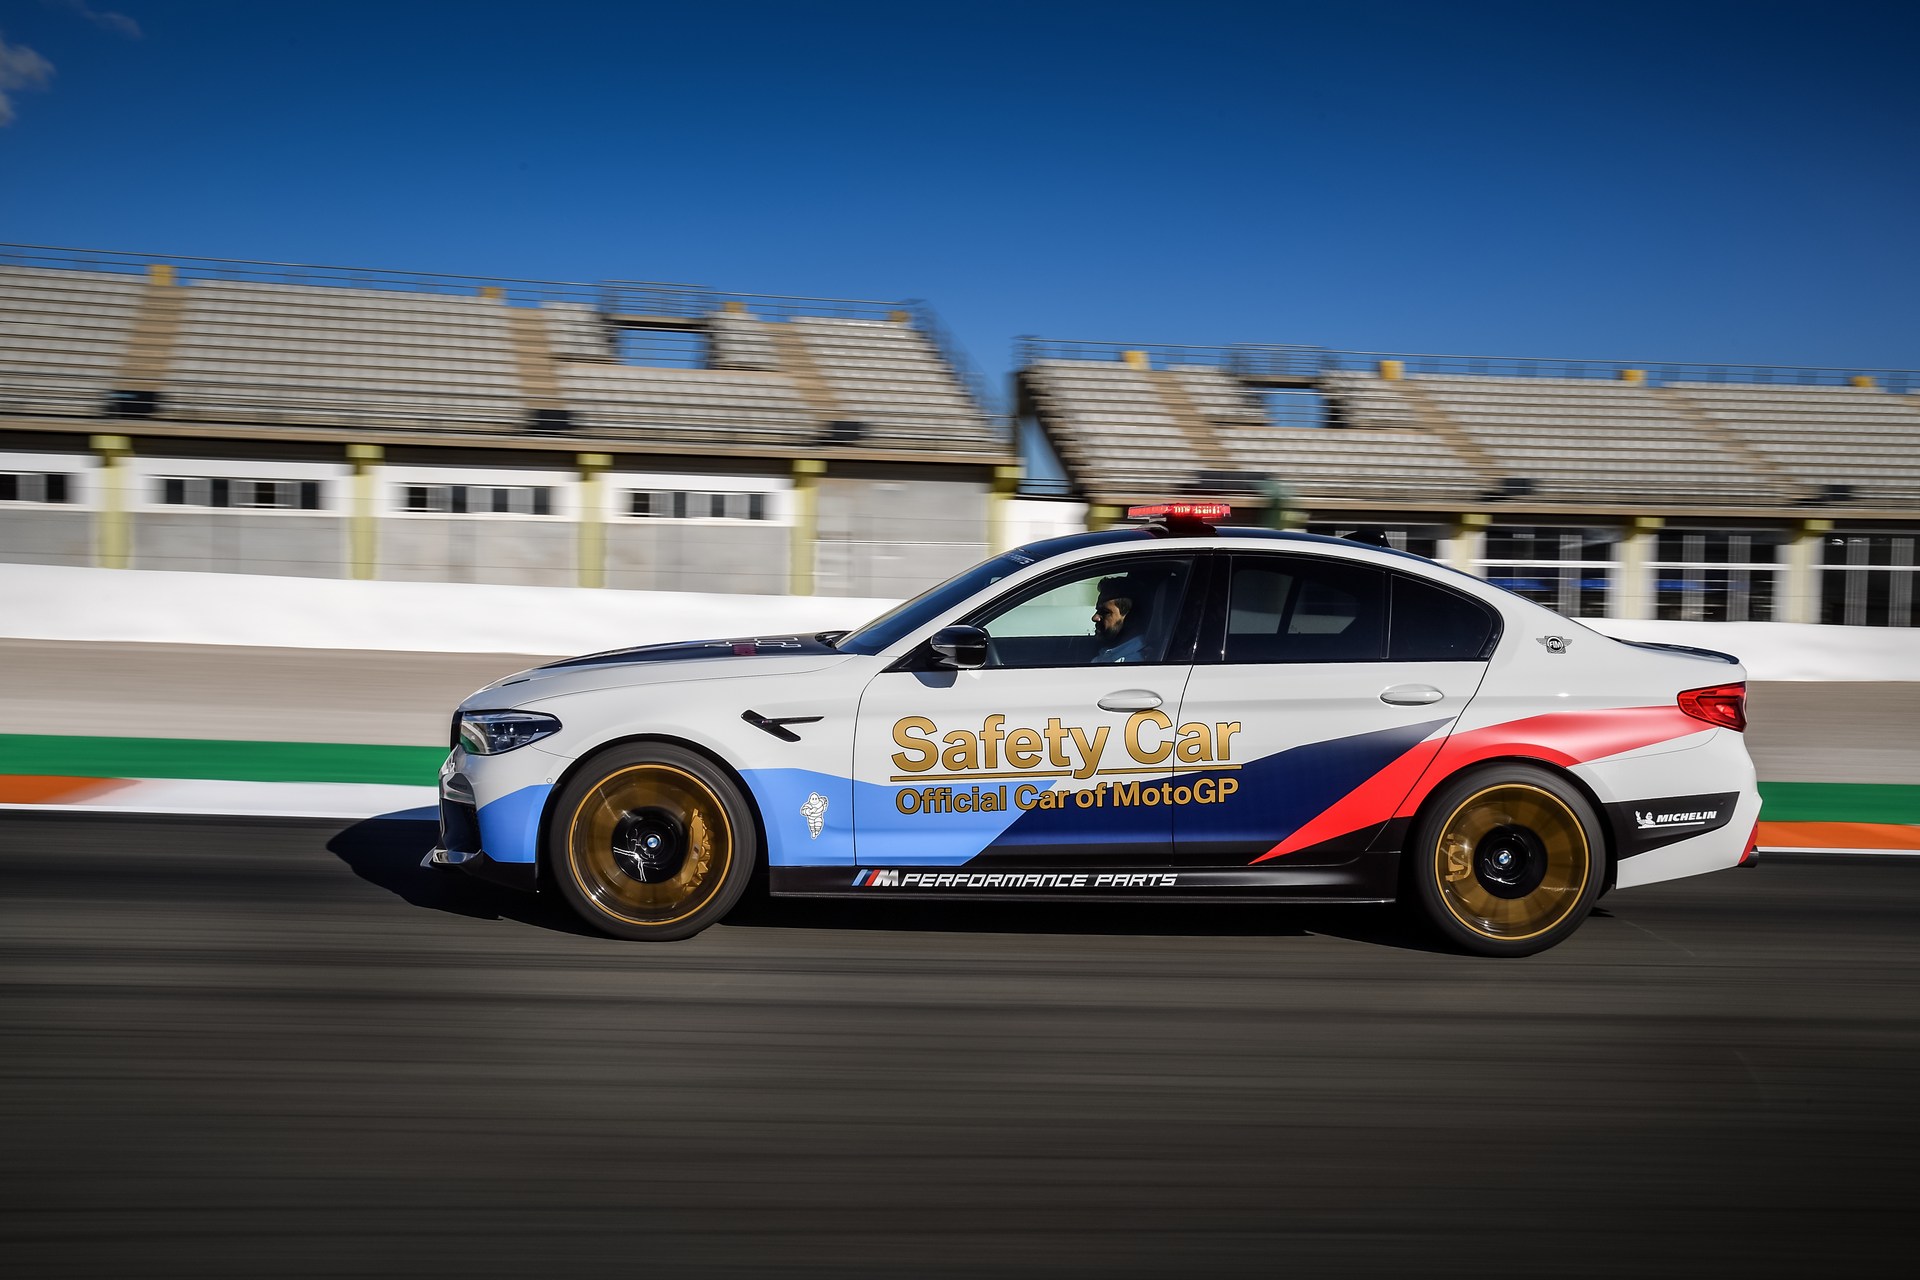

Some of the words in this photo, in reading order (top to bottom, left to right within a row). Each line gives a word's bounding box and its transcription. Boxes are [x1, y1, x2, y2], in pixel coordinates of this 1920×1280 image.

[1550, 640, 1561, 649] FIM
[890, 713, 1111, 779] Safety
[1123, 709, 1242, 765] Car
[895, 785, 1007, 815] Official
[1014, 784, 1070, 811] Car
[1075, 782, 1107, 808] of
[1112, 777, 1239, 807] MotoGP
[1656, 810, 1718, 823] MICHELIN
[900, 873, 1089, 888] PERFORMANCE
[1094, 872, 1179, 887] PARTS
